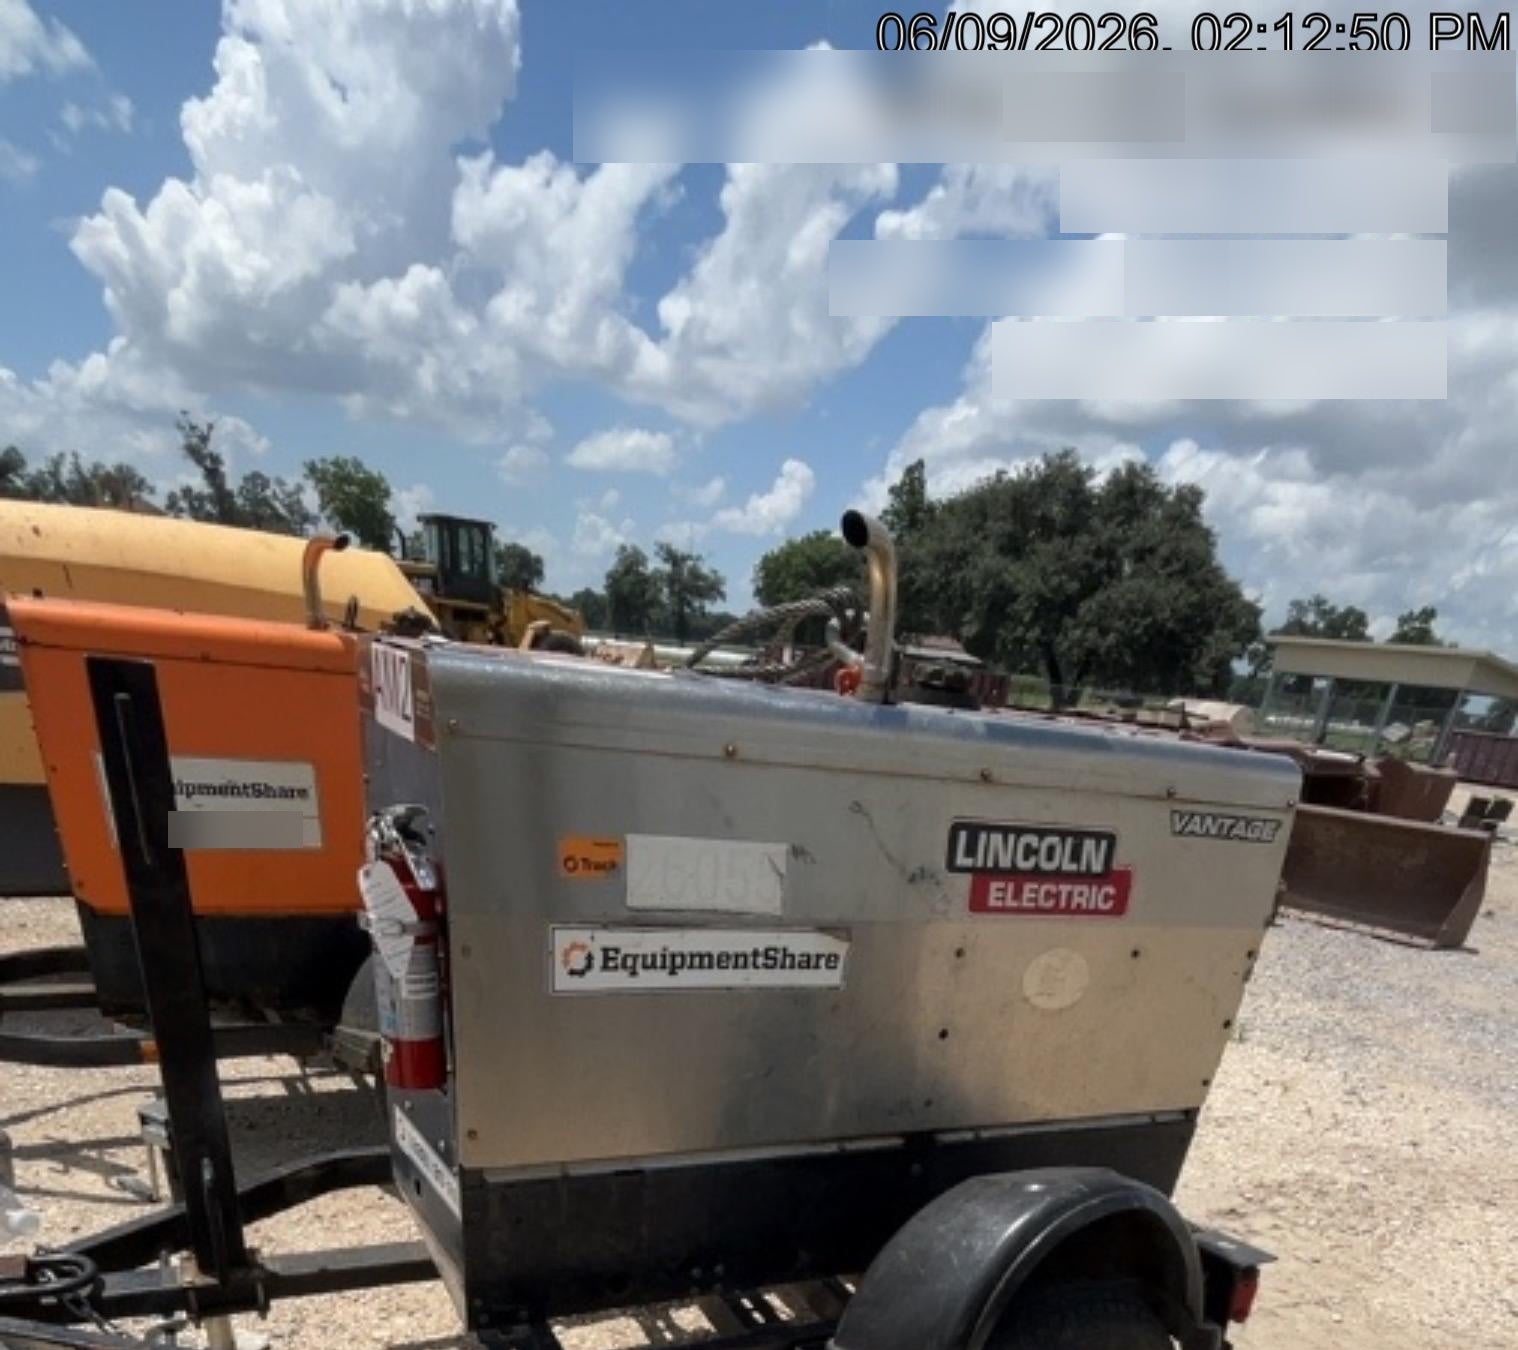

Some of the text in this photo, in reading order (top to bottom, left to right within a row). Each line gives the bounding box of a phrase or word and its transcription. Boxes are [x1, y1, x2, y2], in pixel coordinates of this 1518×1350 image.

[1170, 811, 1279, 842] VANTAGE
[954, 829, 1108, 873] LINCOLN
[987, 881, 1117, 911] ELECTRIC
[600, 946, 840, 977] EquipmentShare
